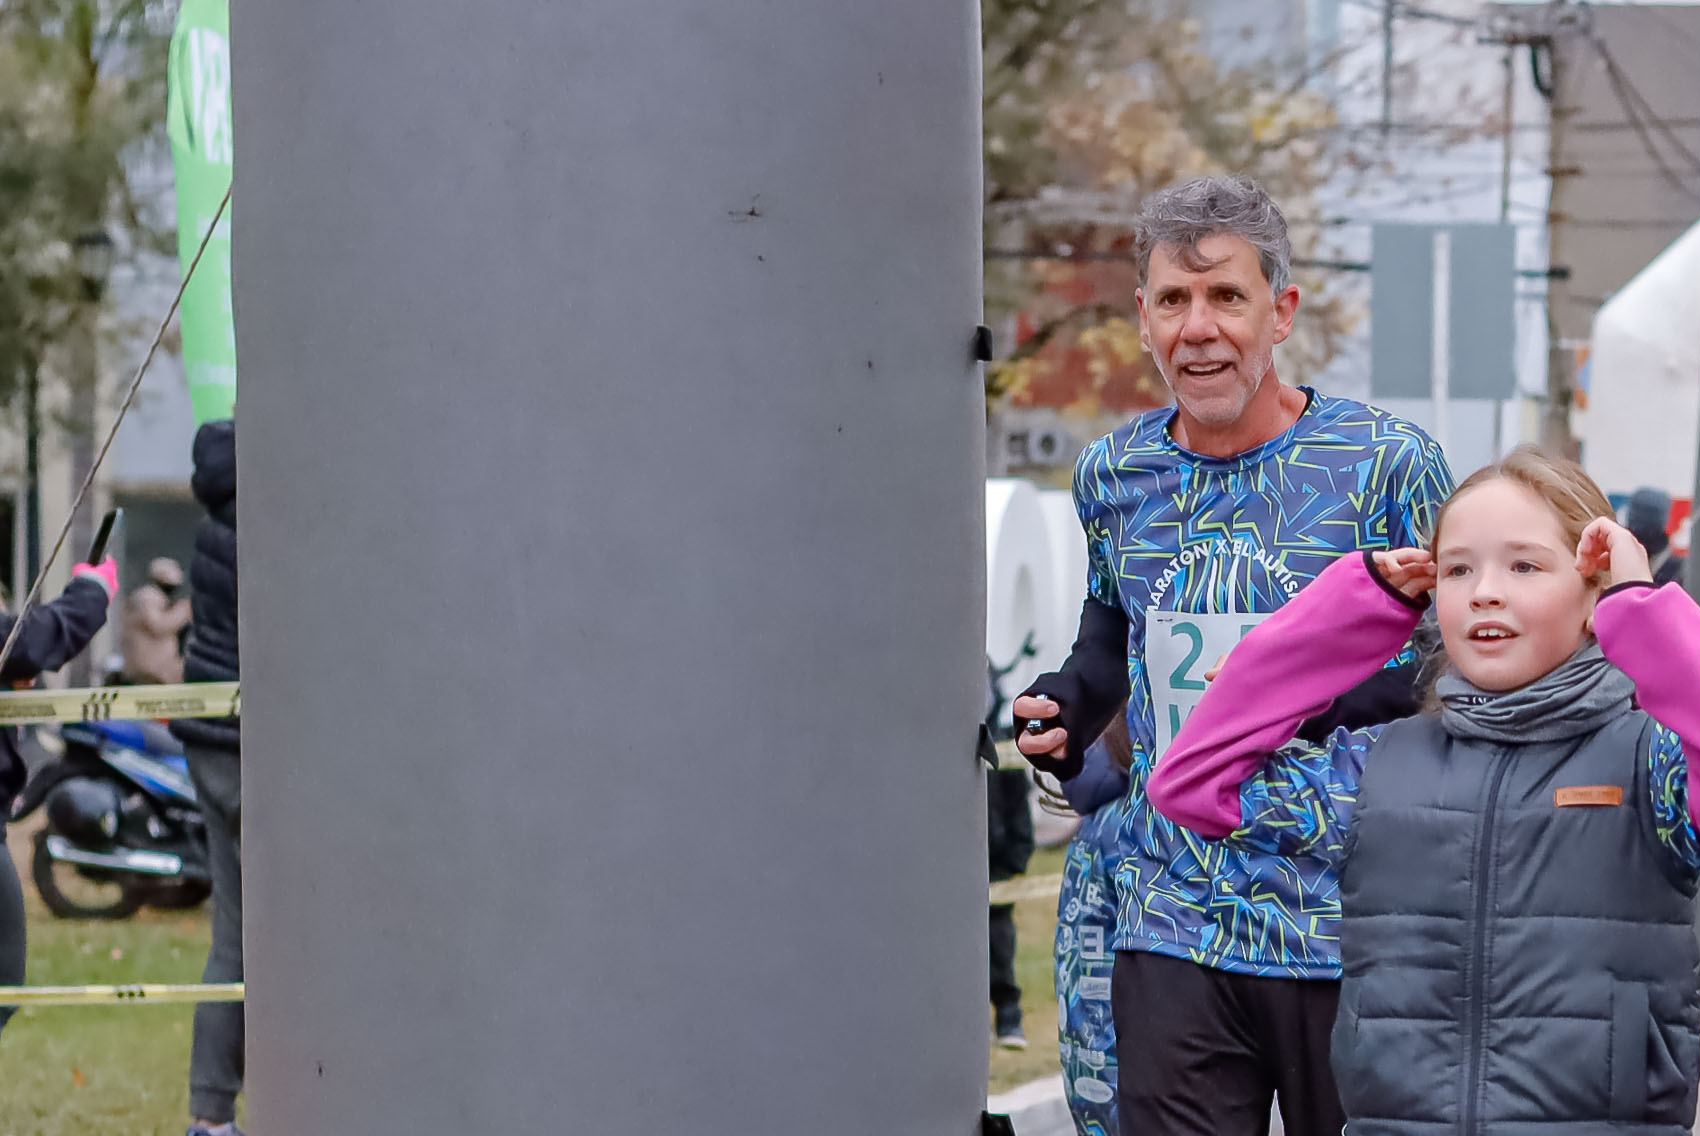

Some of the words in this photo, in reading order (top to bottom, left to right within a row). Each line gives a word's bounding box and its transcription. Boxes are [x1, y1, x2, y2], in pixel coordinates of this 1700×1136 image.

[1215, 539, 1228, 555] X
[1232, 540, 1251, 558] EL
[1253, 548, 1300, 598] AUTIS
